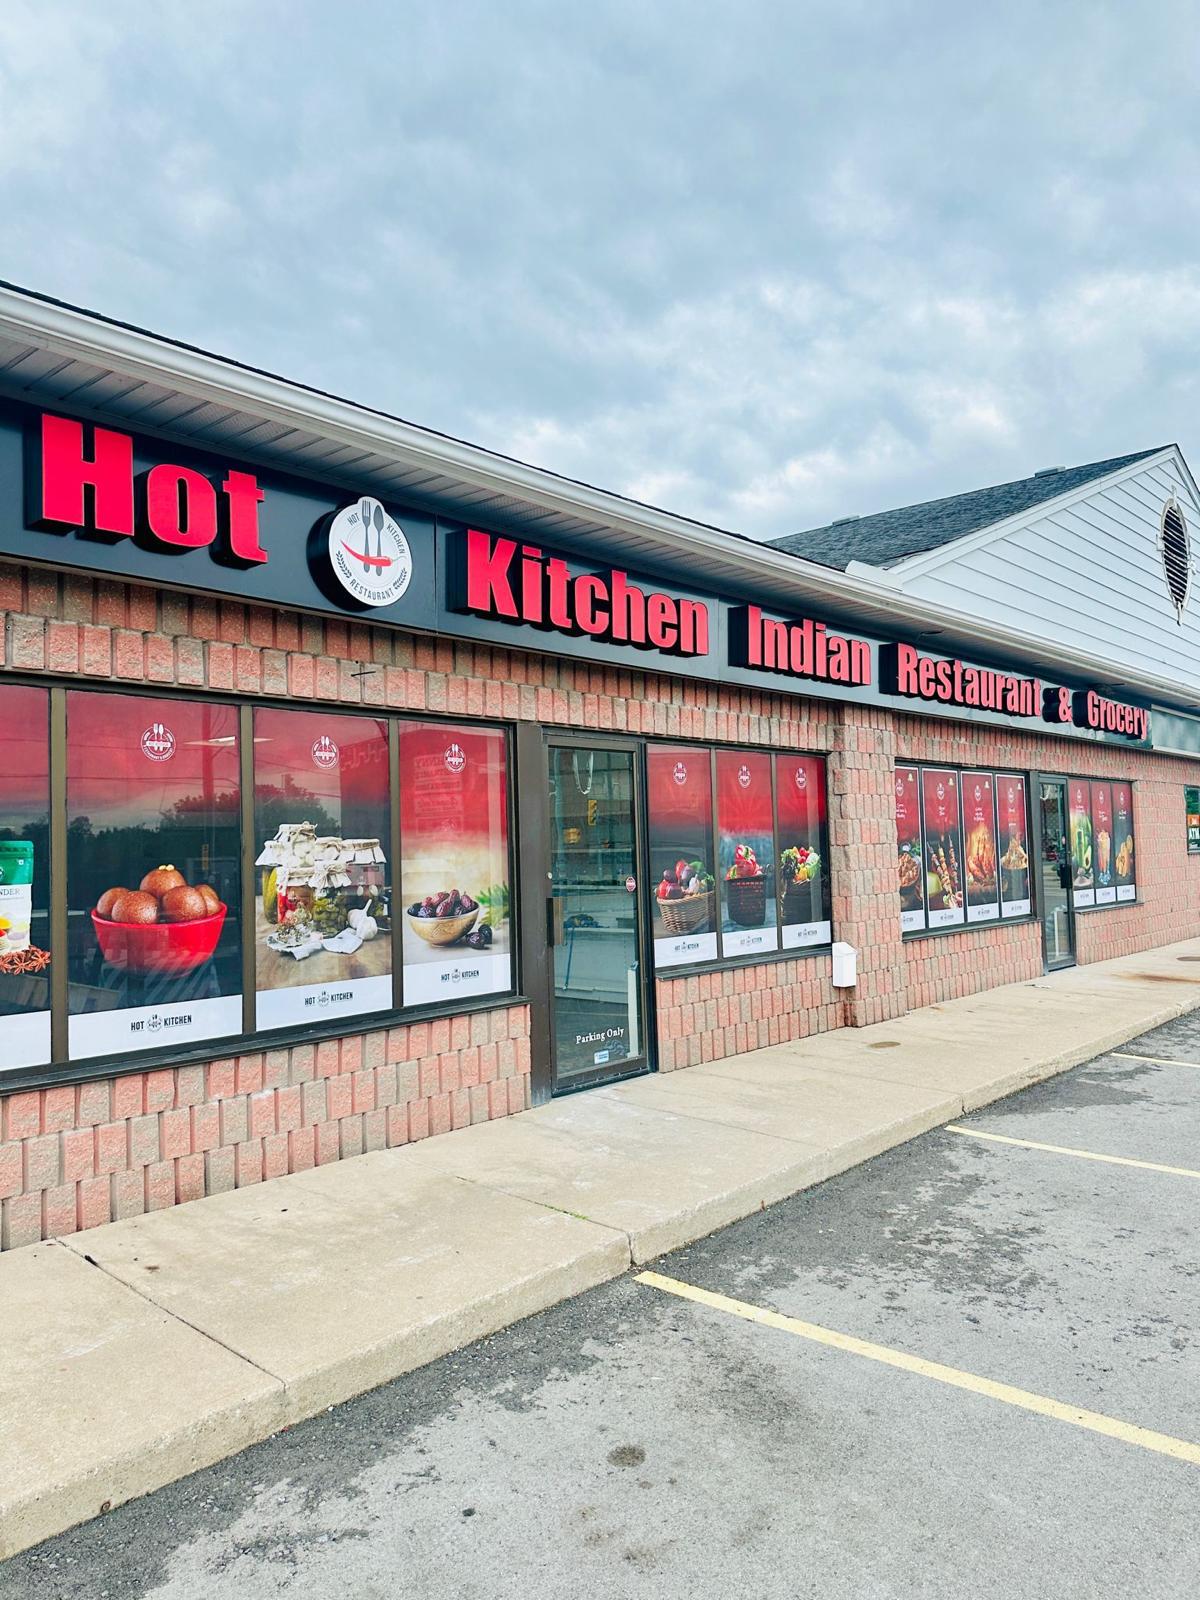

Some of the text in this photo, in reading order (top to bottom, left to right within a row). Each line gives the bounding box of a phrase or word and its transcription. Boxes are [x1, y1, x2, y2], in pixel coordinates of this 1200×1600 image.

[347, 512, 406, 555] HOT KITCHEN
[41, 413, 1148, 740] Hot Kitchen Indian Restaurant & Grocery
[349, 578, 395, 601] RESTAURANT
[304, 991, 353, 1006] HOT KITCHEN
[130, 1014, 192, 1031] HOT KITCHEN
[576, 1026, 625, 1045] Parking Only
